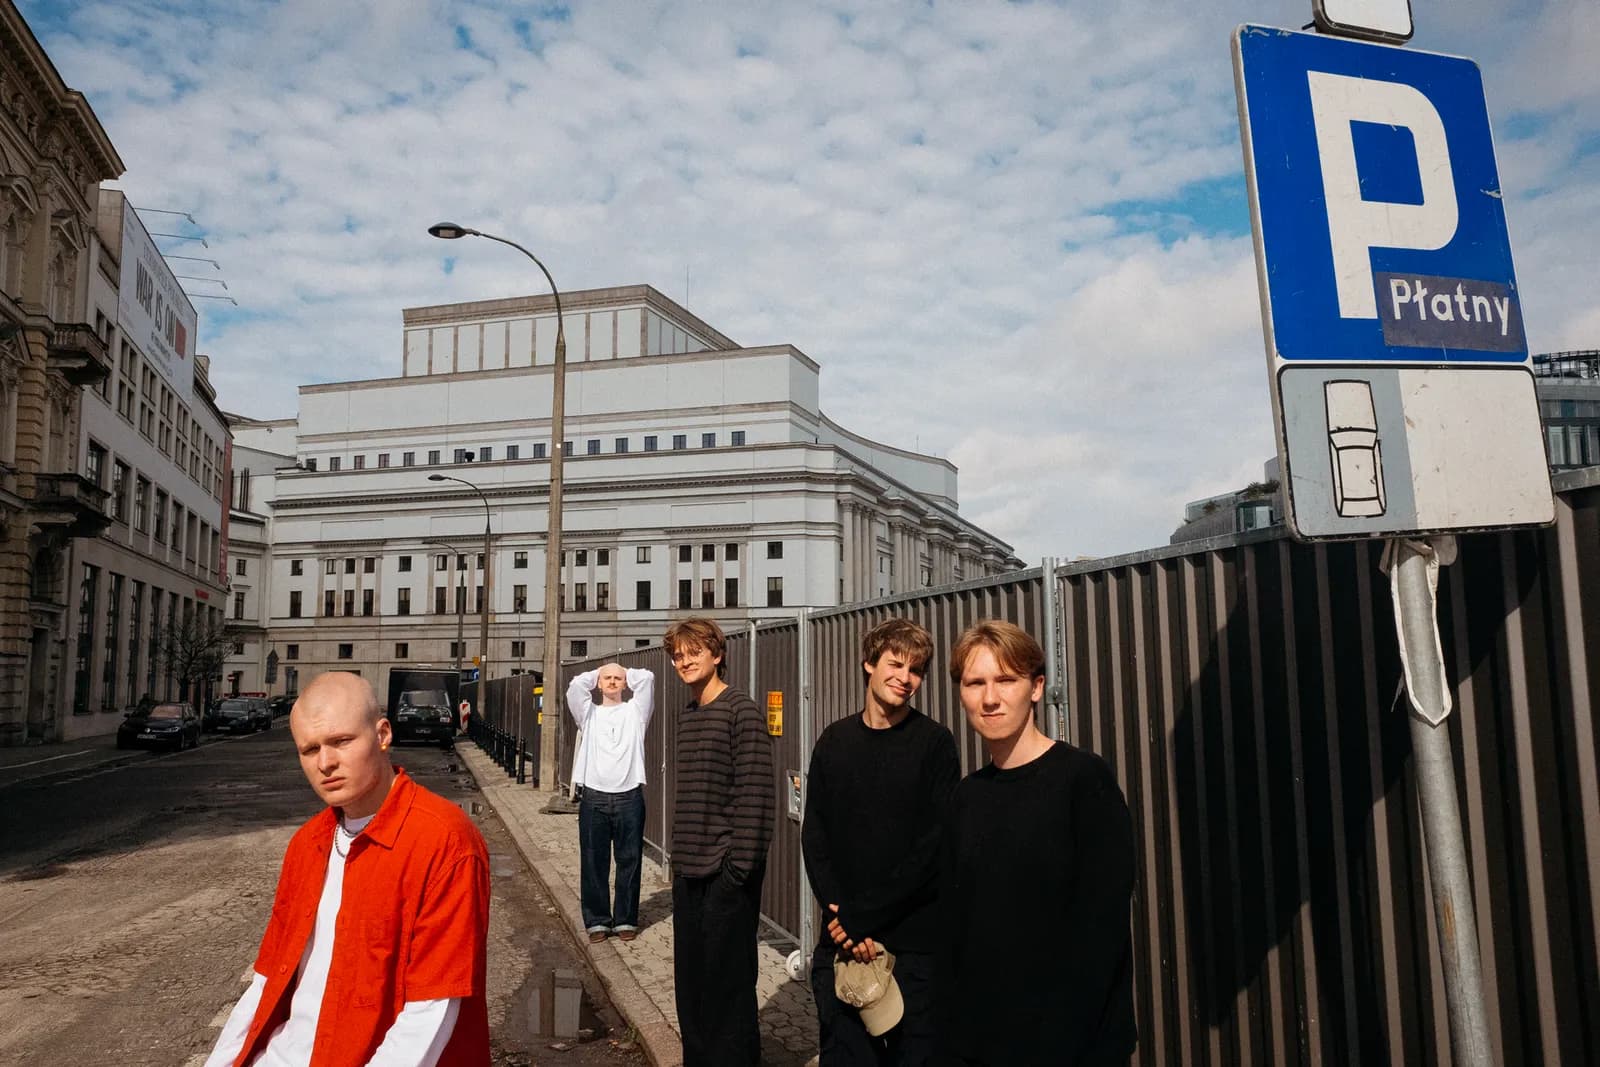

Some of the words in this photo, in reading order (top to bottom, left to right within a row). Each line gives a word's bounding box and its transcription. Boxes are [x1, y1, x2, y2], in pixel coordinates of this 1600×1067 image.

[1307, 70, 1459, 320] P
[136, 257, 153, 318] WAR
[154, 289, 163, 332] IS
[1390, 278, 1509, 336] Płatny
